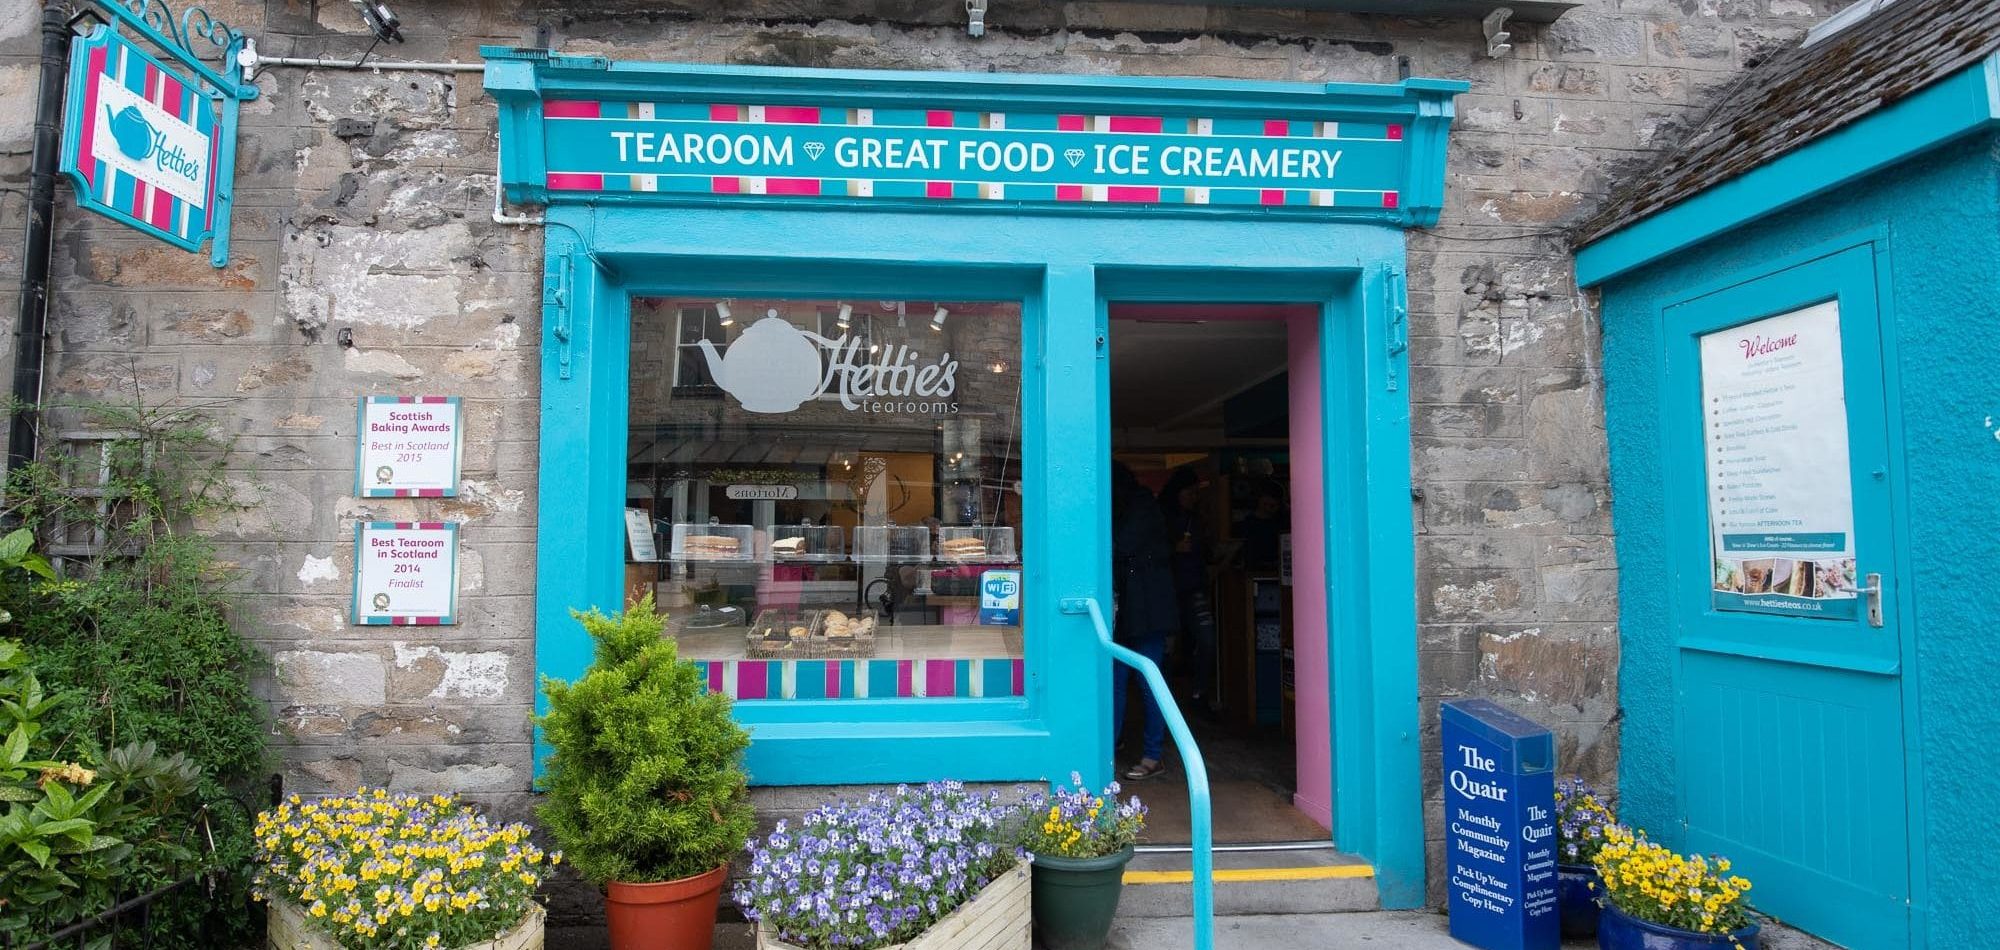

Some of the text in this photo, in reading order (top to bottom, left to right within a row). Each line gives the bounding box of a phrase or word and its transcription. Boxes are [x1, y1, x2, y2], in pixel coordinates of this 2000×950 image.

[153, 131, 199, 181] Hettie's
[610, 130, 1343, 180] TEAROOM GREAT FOOD ICE CREAMERY
[1738, 333, 1798, 360] Welcome
[822, 333, 959, 411] Hettie's
[389, 411, 433, 421] Scottish
[863, 401, 959, 414] tearooms
[371, 423, 451, 434] Baking Awards
[371, 441, 450, 451] Best in Scotland
[396, 453, 423, 463] 2015
[371, 537, 445, 547] Best Tearoom
[377, 549, 438, 559] in Scotland
[393, 563, 421, 573] 2014
[388, 578, 425, 588] Finalist
[1458, 744, 1496, 773] The
[1450, 770, 1508, 802] Quair
[1458, 808, 1502, 833] Monthly
[1527, 805, 1547, 821] The
[1451, 822, 1510, 851] Community
[1522, 823, 1553, 843] Quair
[1457, 839, 1506, 863] Magazine
[1527, 848, 1550, 860] Monthly
[1456, 864, 1508, 890] Pick Up Your
[1452, 876, 1514, 907] Complimentary
[1462, 892, 1505, 915] Copy Here
